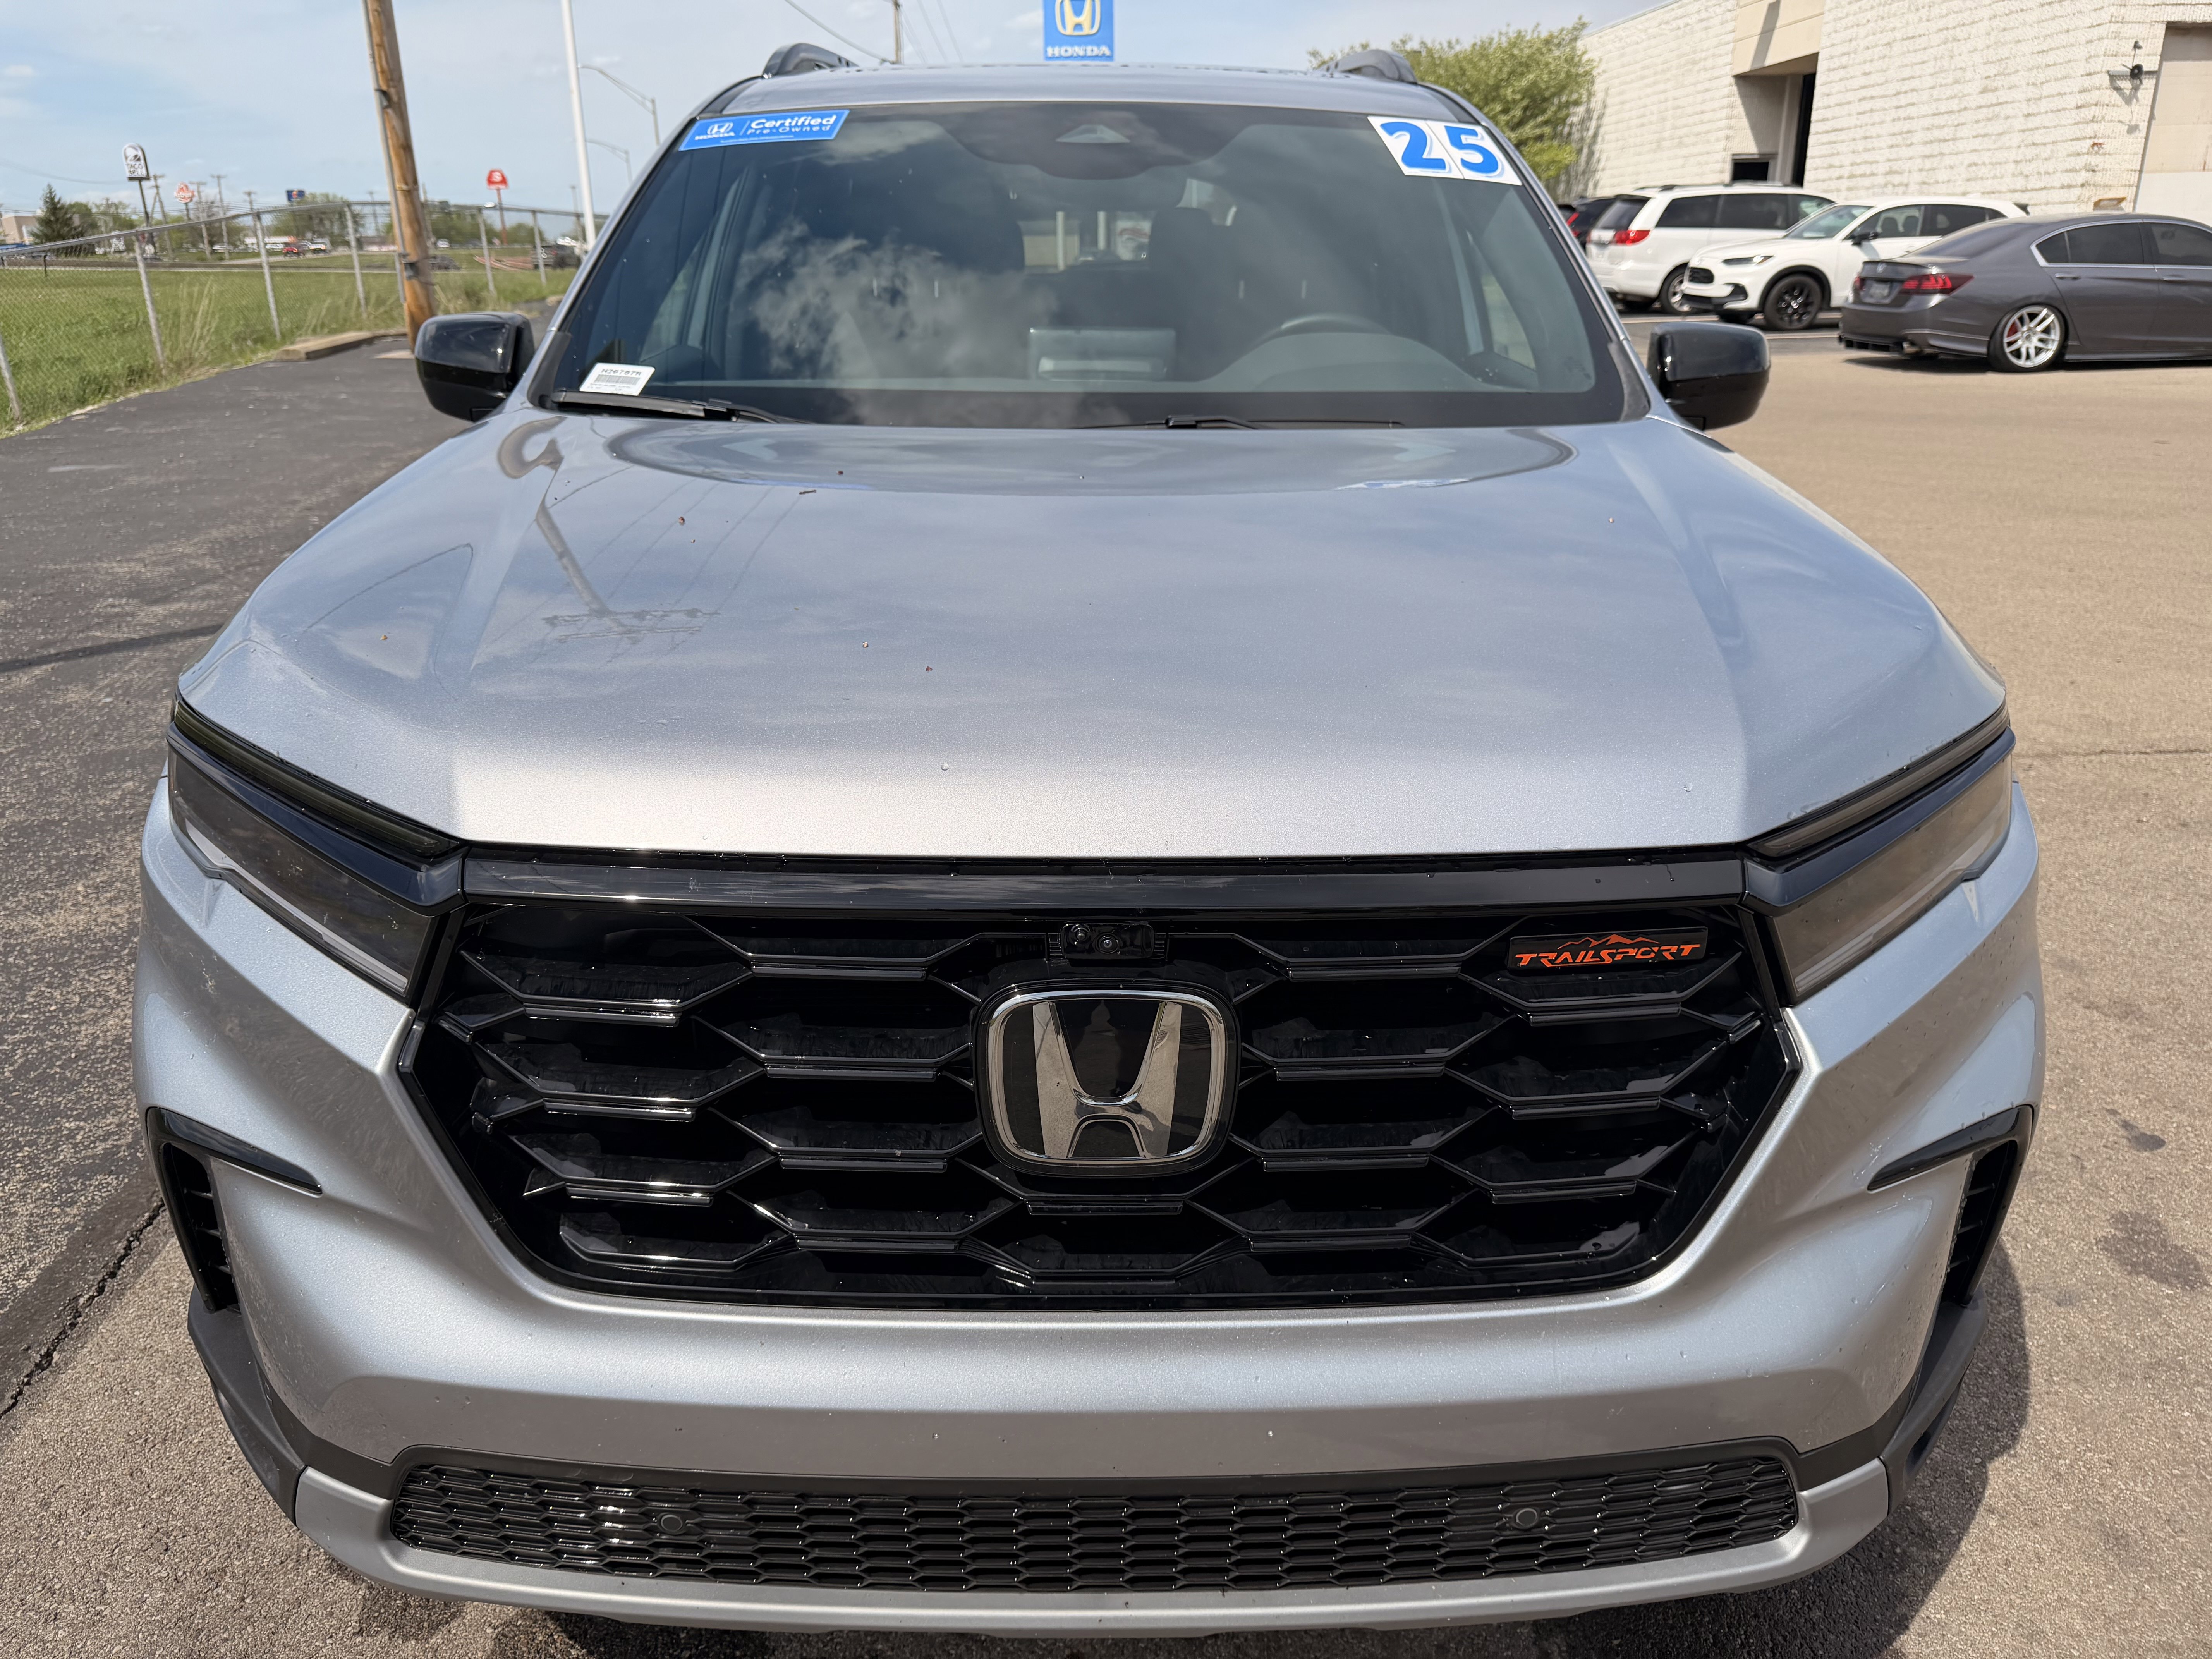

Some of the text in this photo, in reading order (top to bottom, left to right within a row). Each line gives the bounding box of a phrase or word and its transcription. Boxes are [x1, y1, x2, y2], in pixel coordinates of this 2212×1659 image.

[1046, 45, 1111, 57] HONDA
[750, 115, 837, 129] Certified
[746, 125, 831, 135] Pre-Owned
[1379, 121, 1506, 177] 25
[1515, 944, 1701, 967] TRAILSPORT
